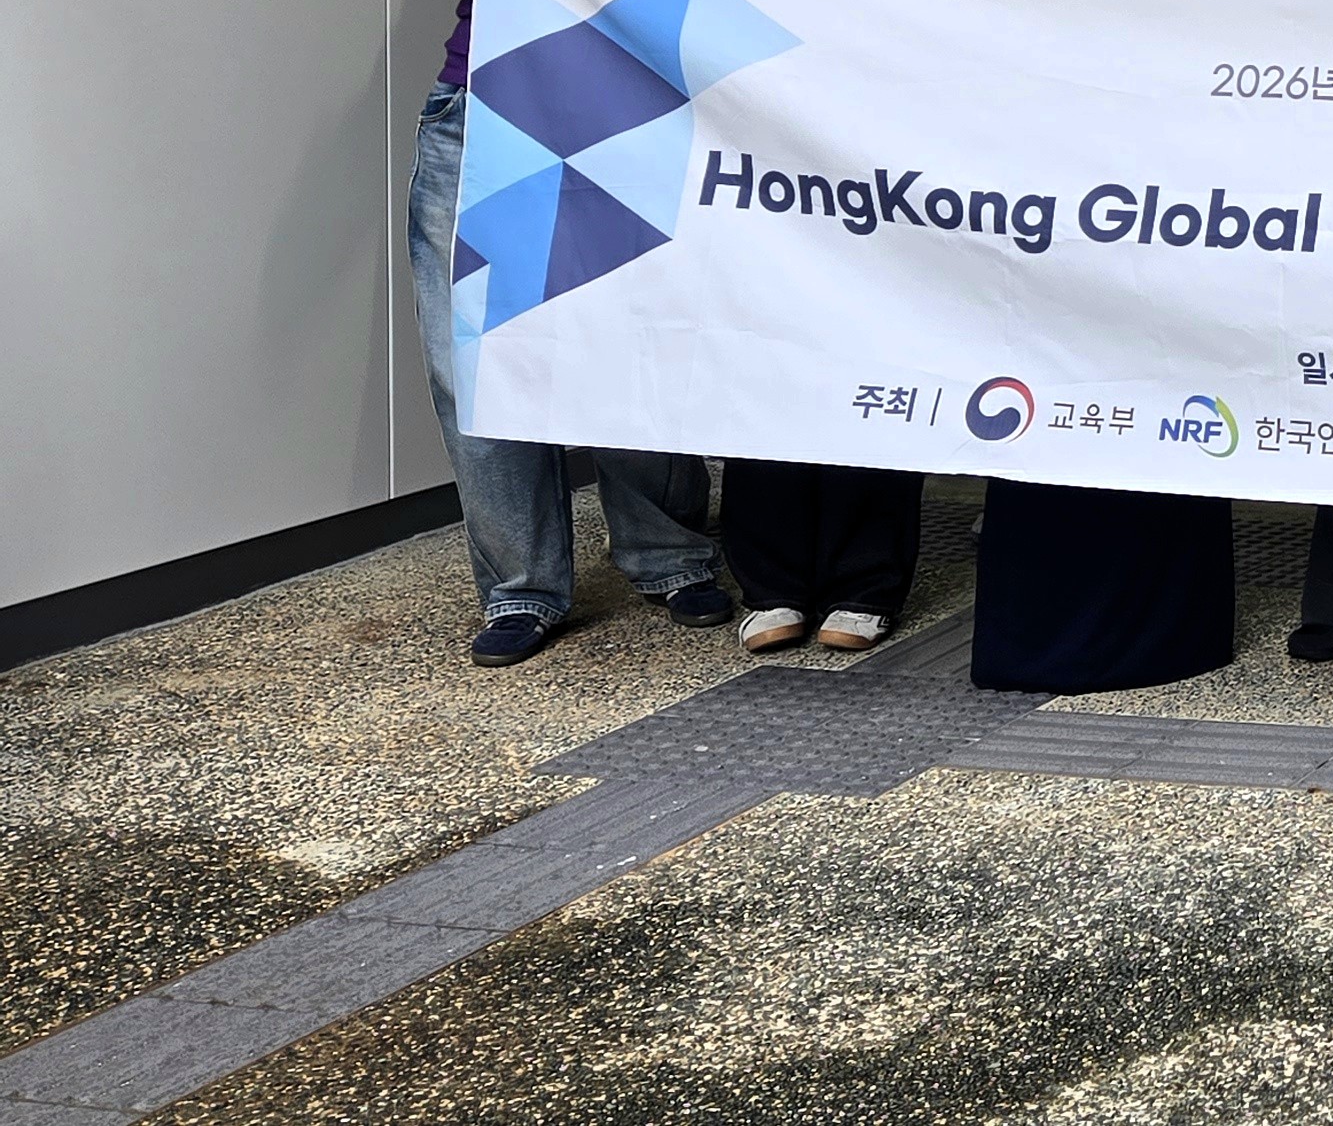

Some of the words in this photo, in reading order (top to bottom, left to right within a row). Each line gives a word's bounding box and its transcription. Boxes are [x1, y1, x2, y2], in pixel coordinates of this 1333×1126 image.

[699, 150, 1057, 254] HongKong
[1077, 183, 1322, 253] Global
[852, 384, 917, 422] 주최
[1048, 402, 1135, 435] 교육부
[1159, 419, 1222, 444] NRF
